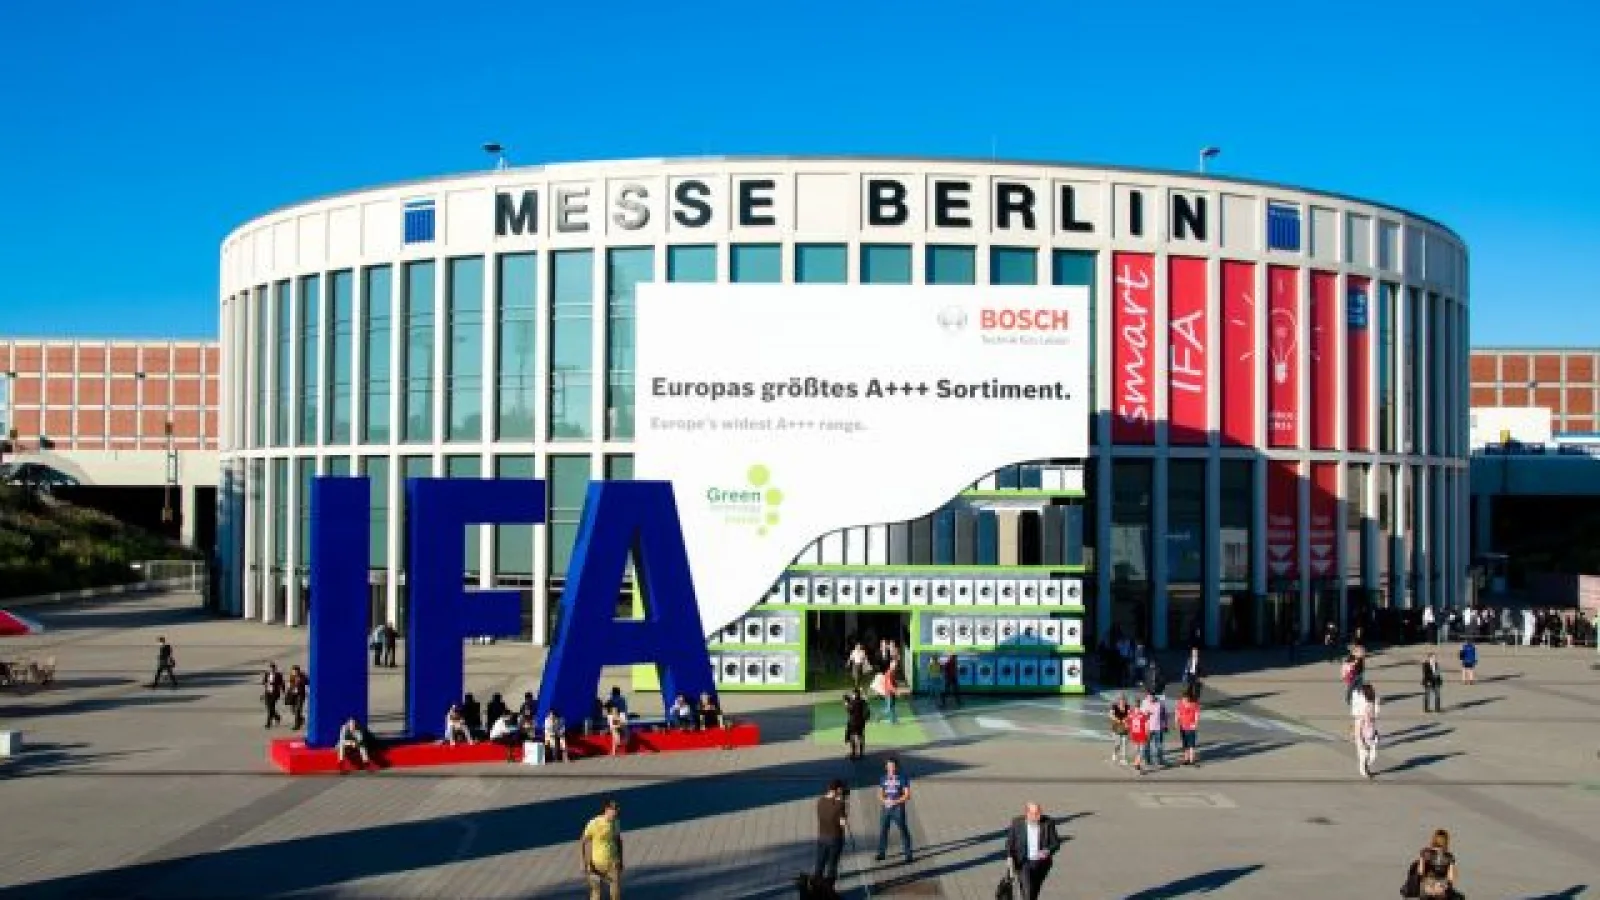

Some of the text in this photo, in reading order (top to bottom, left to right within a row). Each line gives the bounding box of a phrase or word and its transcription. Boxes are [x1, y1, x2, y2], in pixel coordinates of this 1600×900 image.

[495, 179, 1206, 241] MESSE BERLIN
[980, 309, 1068, 330] BOSCH
[1171, 309, 1204, 392] IFA
[651, 376, 1071, 402] Europas größtes A+++ Sortiment.
[650, 416, 718, 432] Europe's
[722, 416, 771, 430] widest
[776, 416, 815, 430] A+++
[706, 486, 761, 503] Green
[305, 476, 719, 748] IFA
